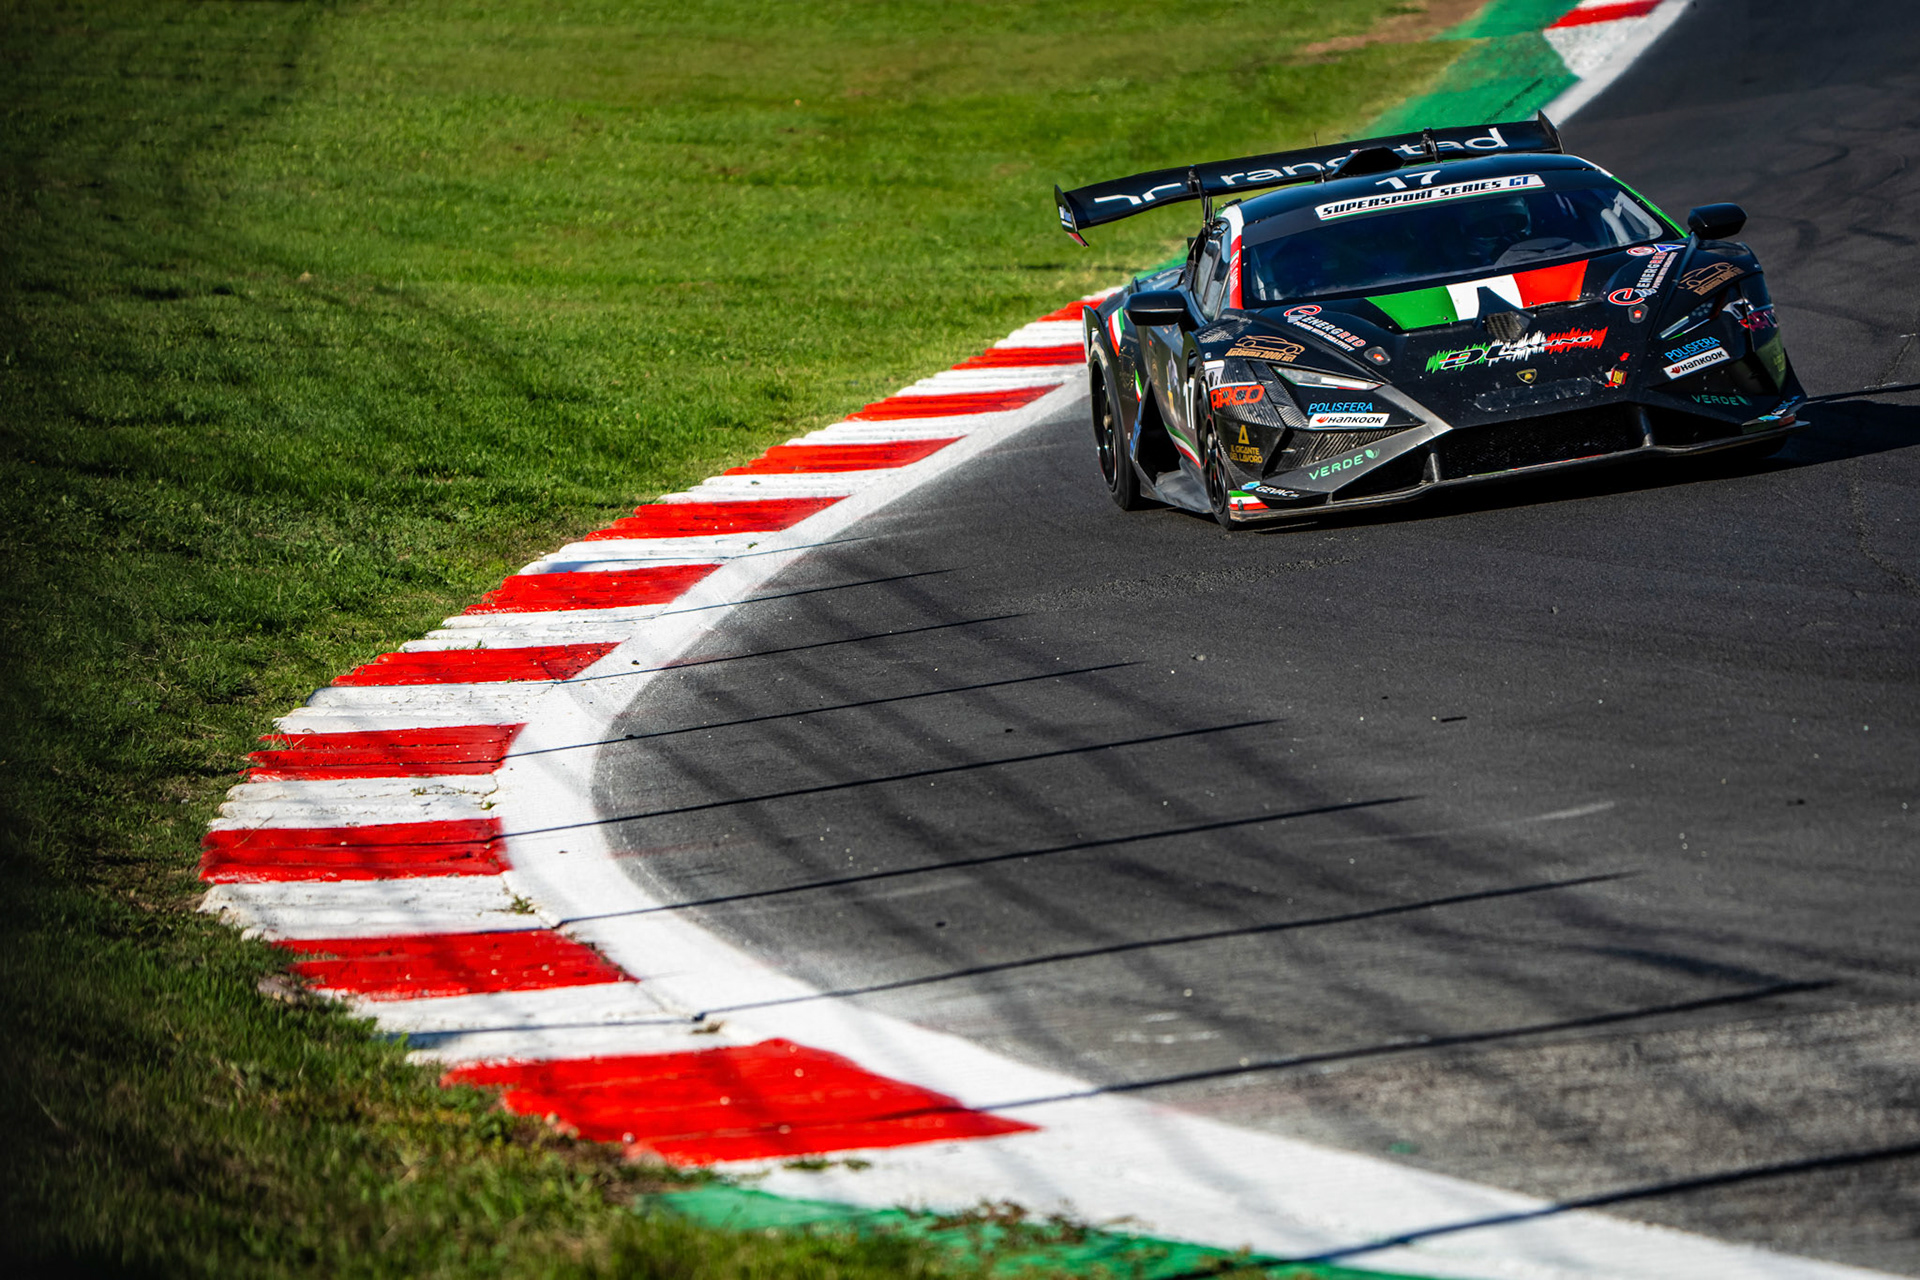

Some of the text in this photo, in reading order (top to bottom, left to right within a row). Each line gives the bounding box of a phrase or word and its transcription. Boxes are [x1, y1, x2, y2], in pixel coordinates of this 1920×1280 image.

[1220, 127, 1509, 186] rantad
[1375, 170, 1441, 190] 17
[1322, 174, 1535, 216] SUPERSPORT SERIES GT
[1301, 316, 1366, 347] ENERGRED
[1664, 336, 1720, 362] POLISFERA
[1307, 402, 1373, 415] POLISFERA
[1691, 394, 1739, 406] VERDE
[1308, 454, 1364, 480] VERDE
